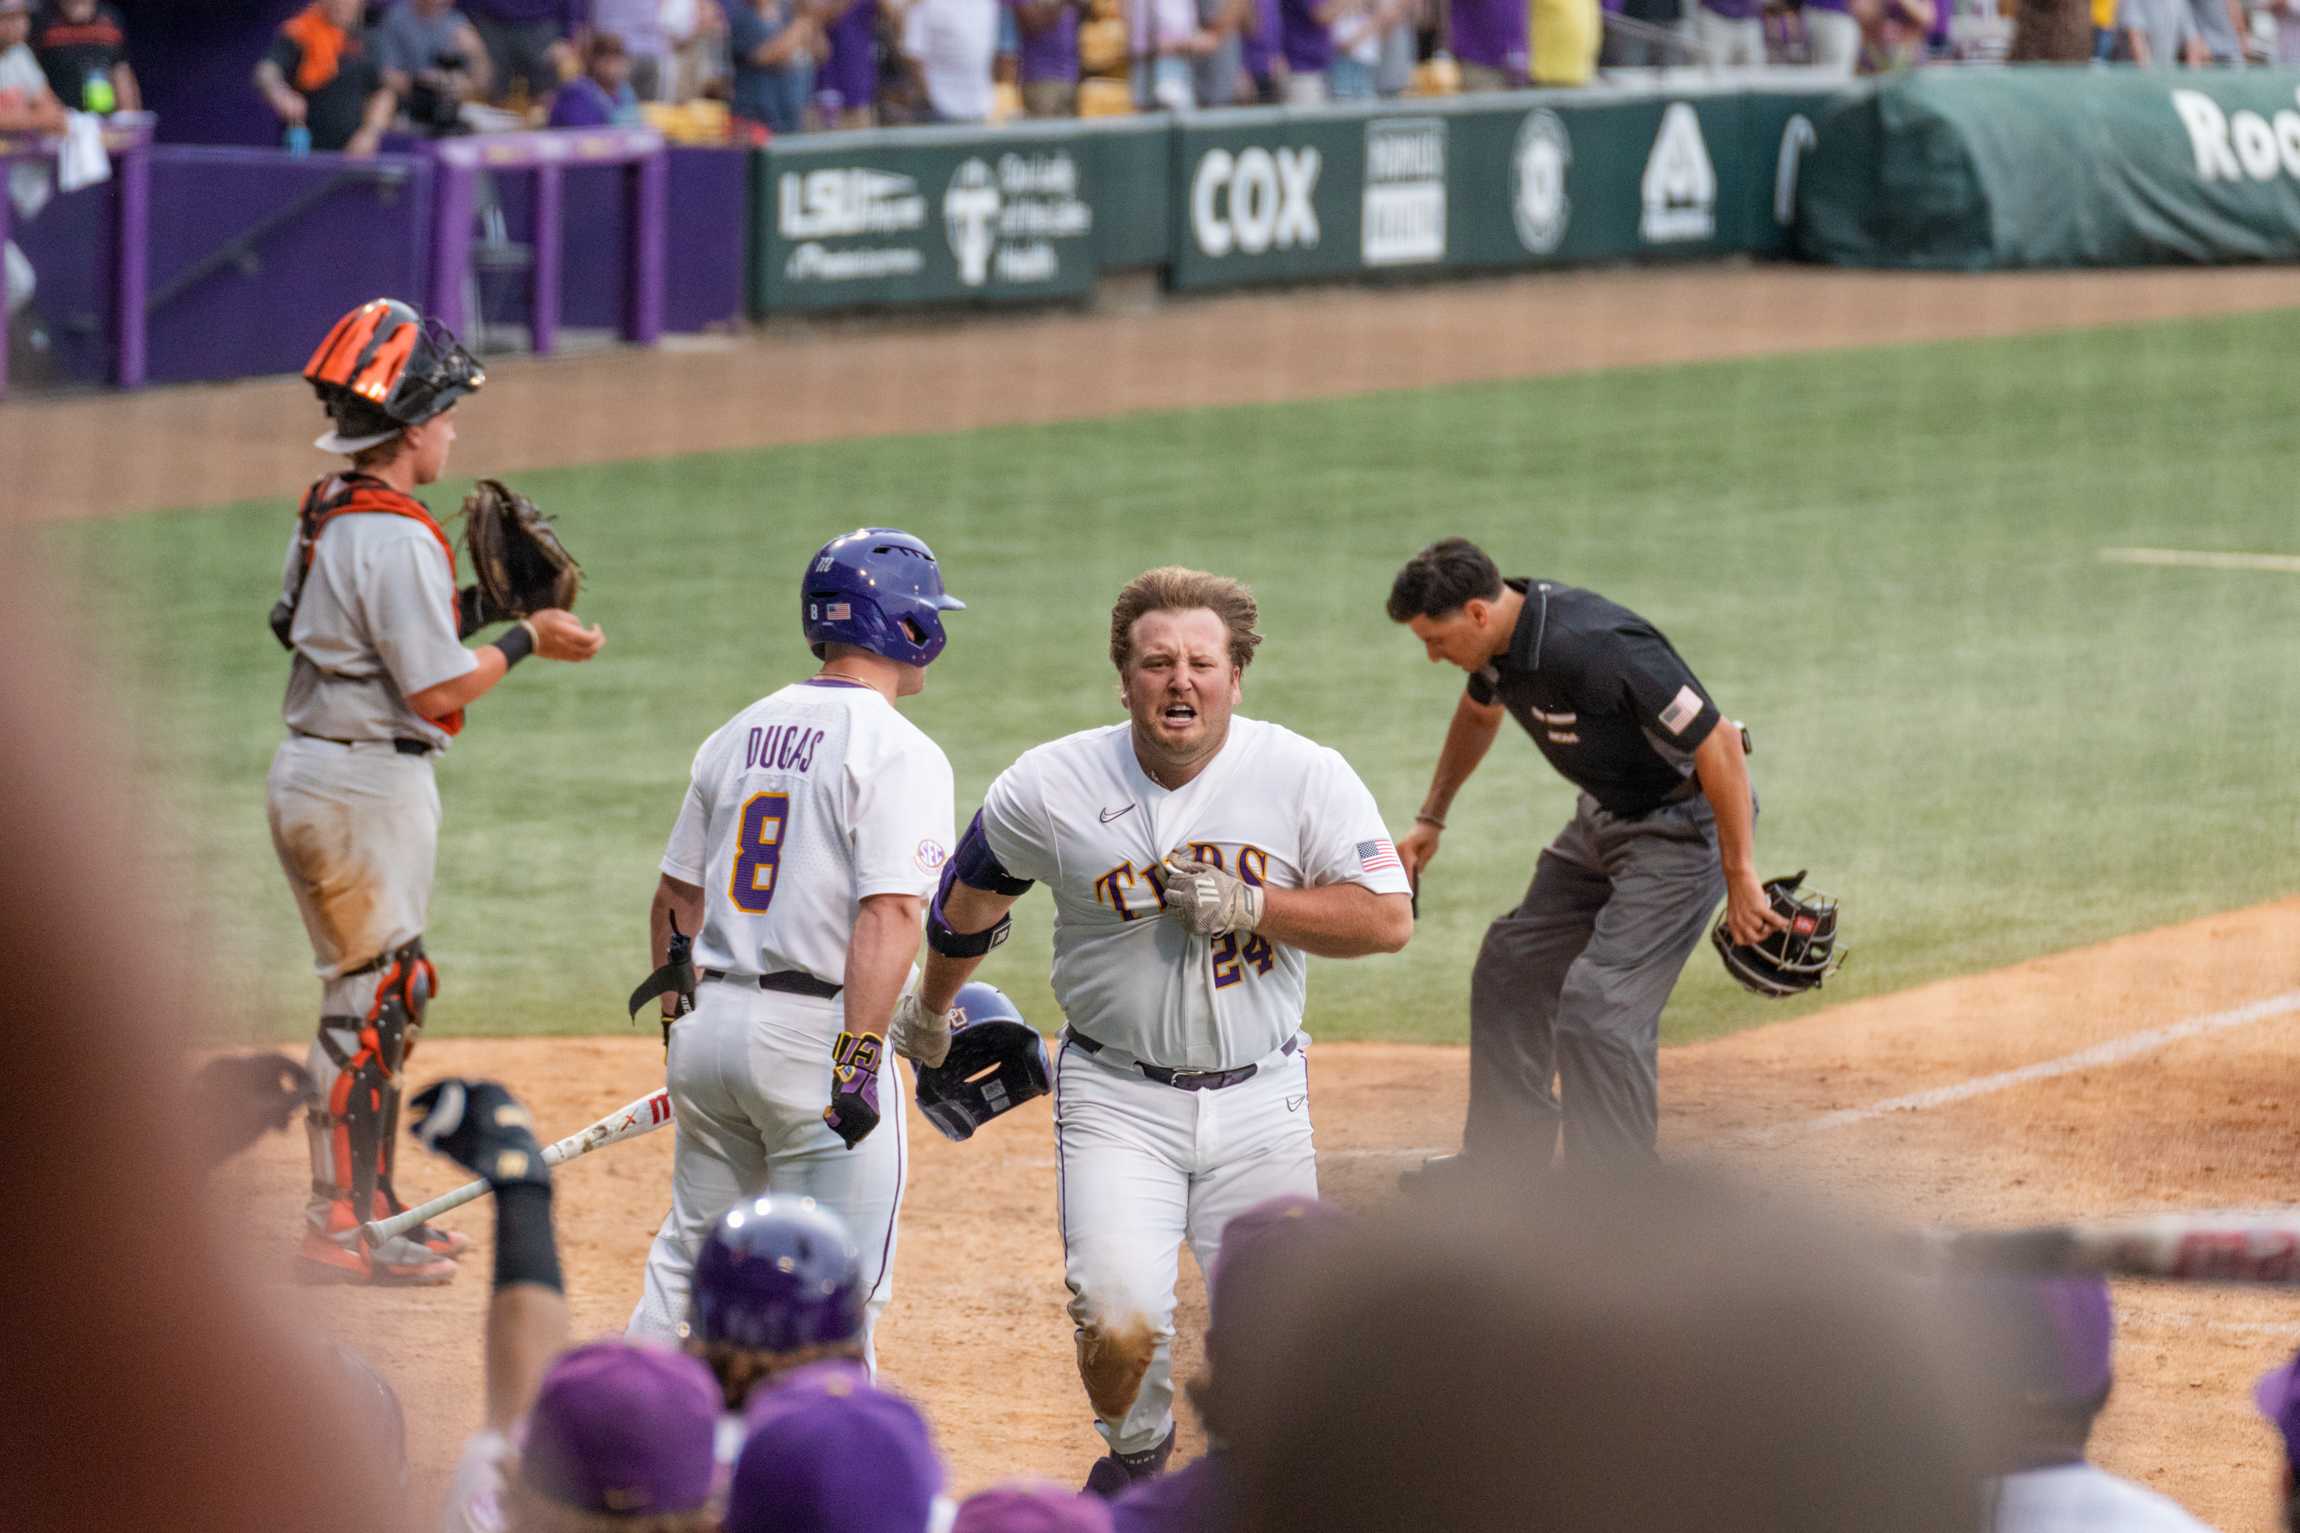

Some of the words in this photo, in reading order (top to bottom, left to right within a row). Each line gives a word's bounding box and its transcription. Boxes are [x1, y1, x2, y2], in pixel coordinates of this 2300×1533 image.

[2170, 84, 2300, 183] Roo
[1191, 146, 1322, 256] COX
[810, 603, 818, 620] 8
[746, 725, 825, 774] DUGAS
[728, 790, 790, 915] 8
[1210, 930, 1275, 991] 24
